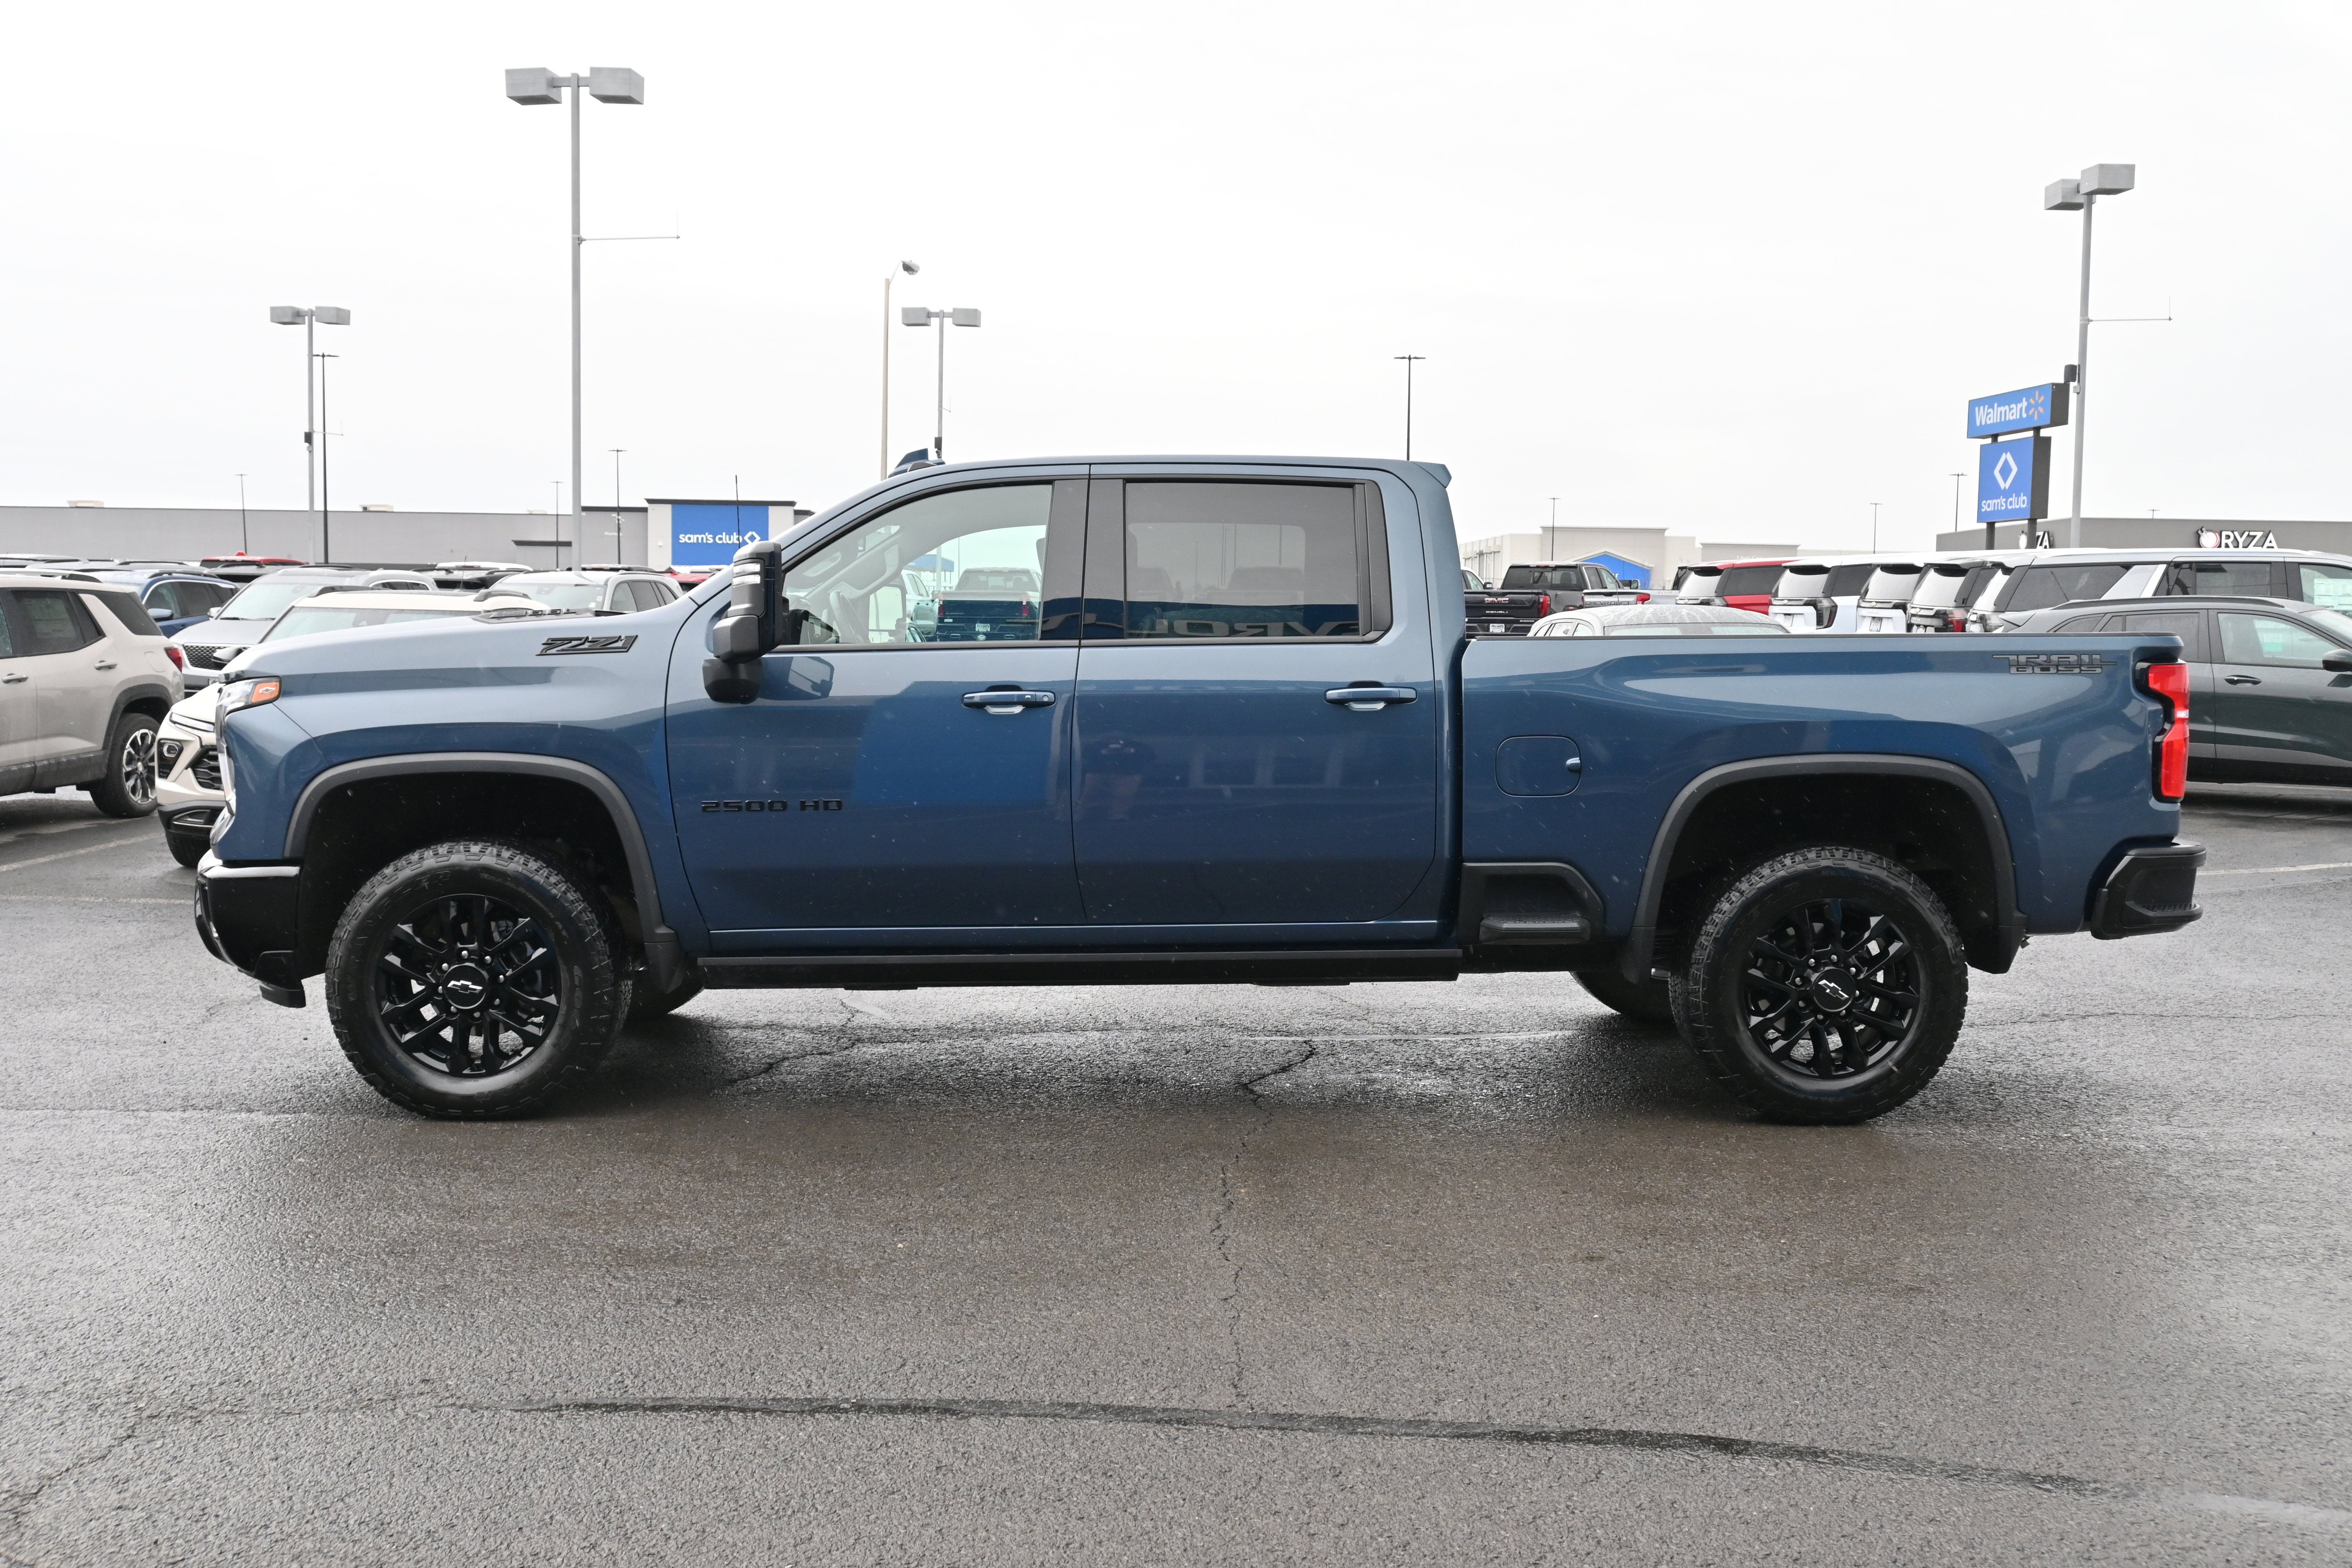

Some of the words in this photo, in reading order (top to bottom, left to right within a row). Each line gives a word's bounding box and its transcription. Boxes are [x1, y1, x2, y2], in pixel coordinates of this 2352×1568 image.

[1975, 397, 2028, 426] Walmart
[1981, 495, 2006, 512] sam's
[2007, 493, 2028, 509] club
[679, 532, 713, 543] sam's
[715, 532, 743, 544] club
[536, 634, 638, 656] Z71
[1992, 654, 2117, 665] TRAIL
[2009, 665, 2102, 674] BOSS
[701, 800, 787, 812] 2500
[800, 799, 843, 811] HD
